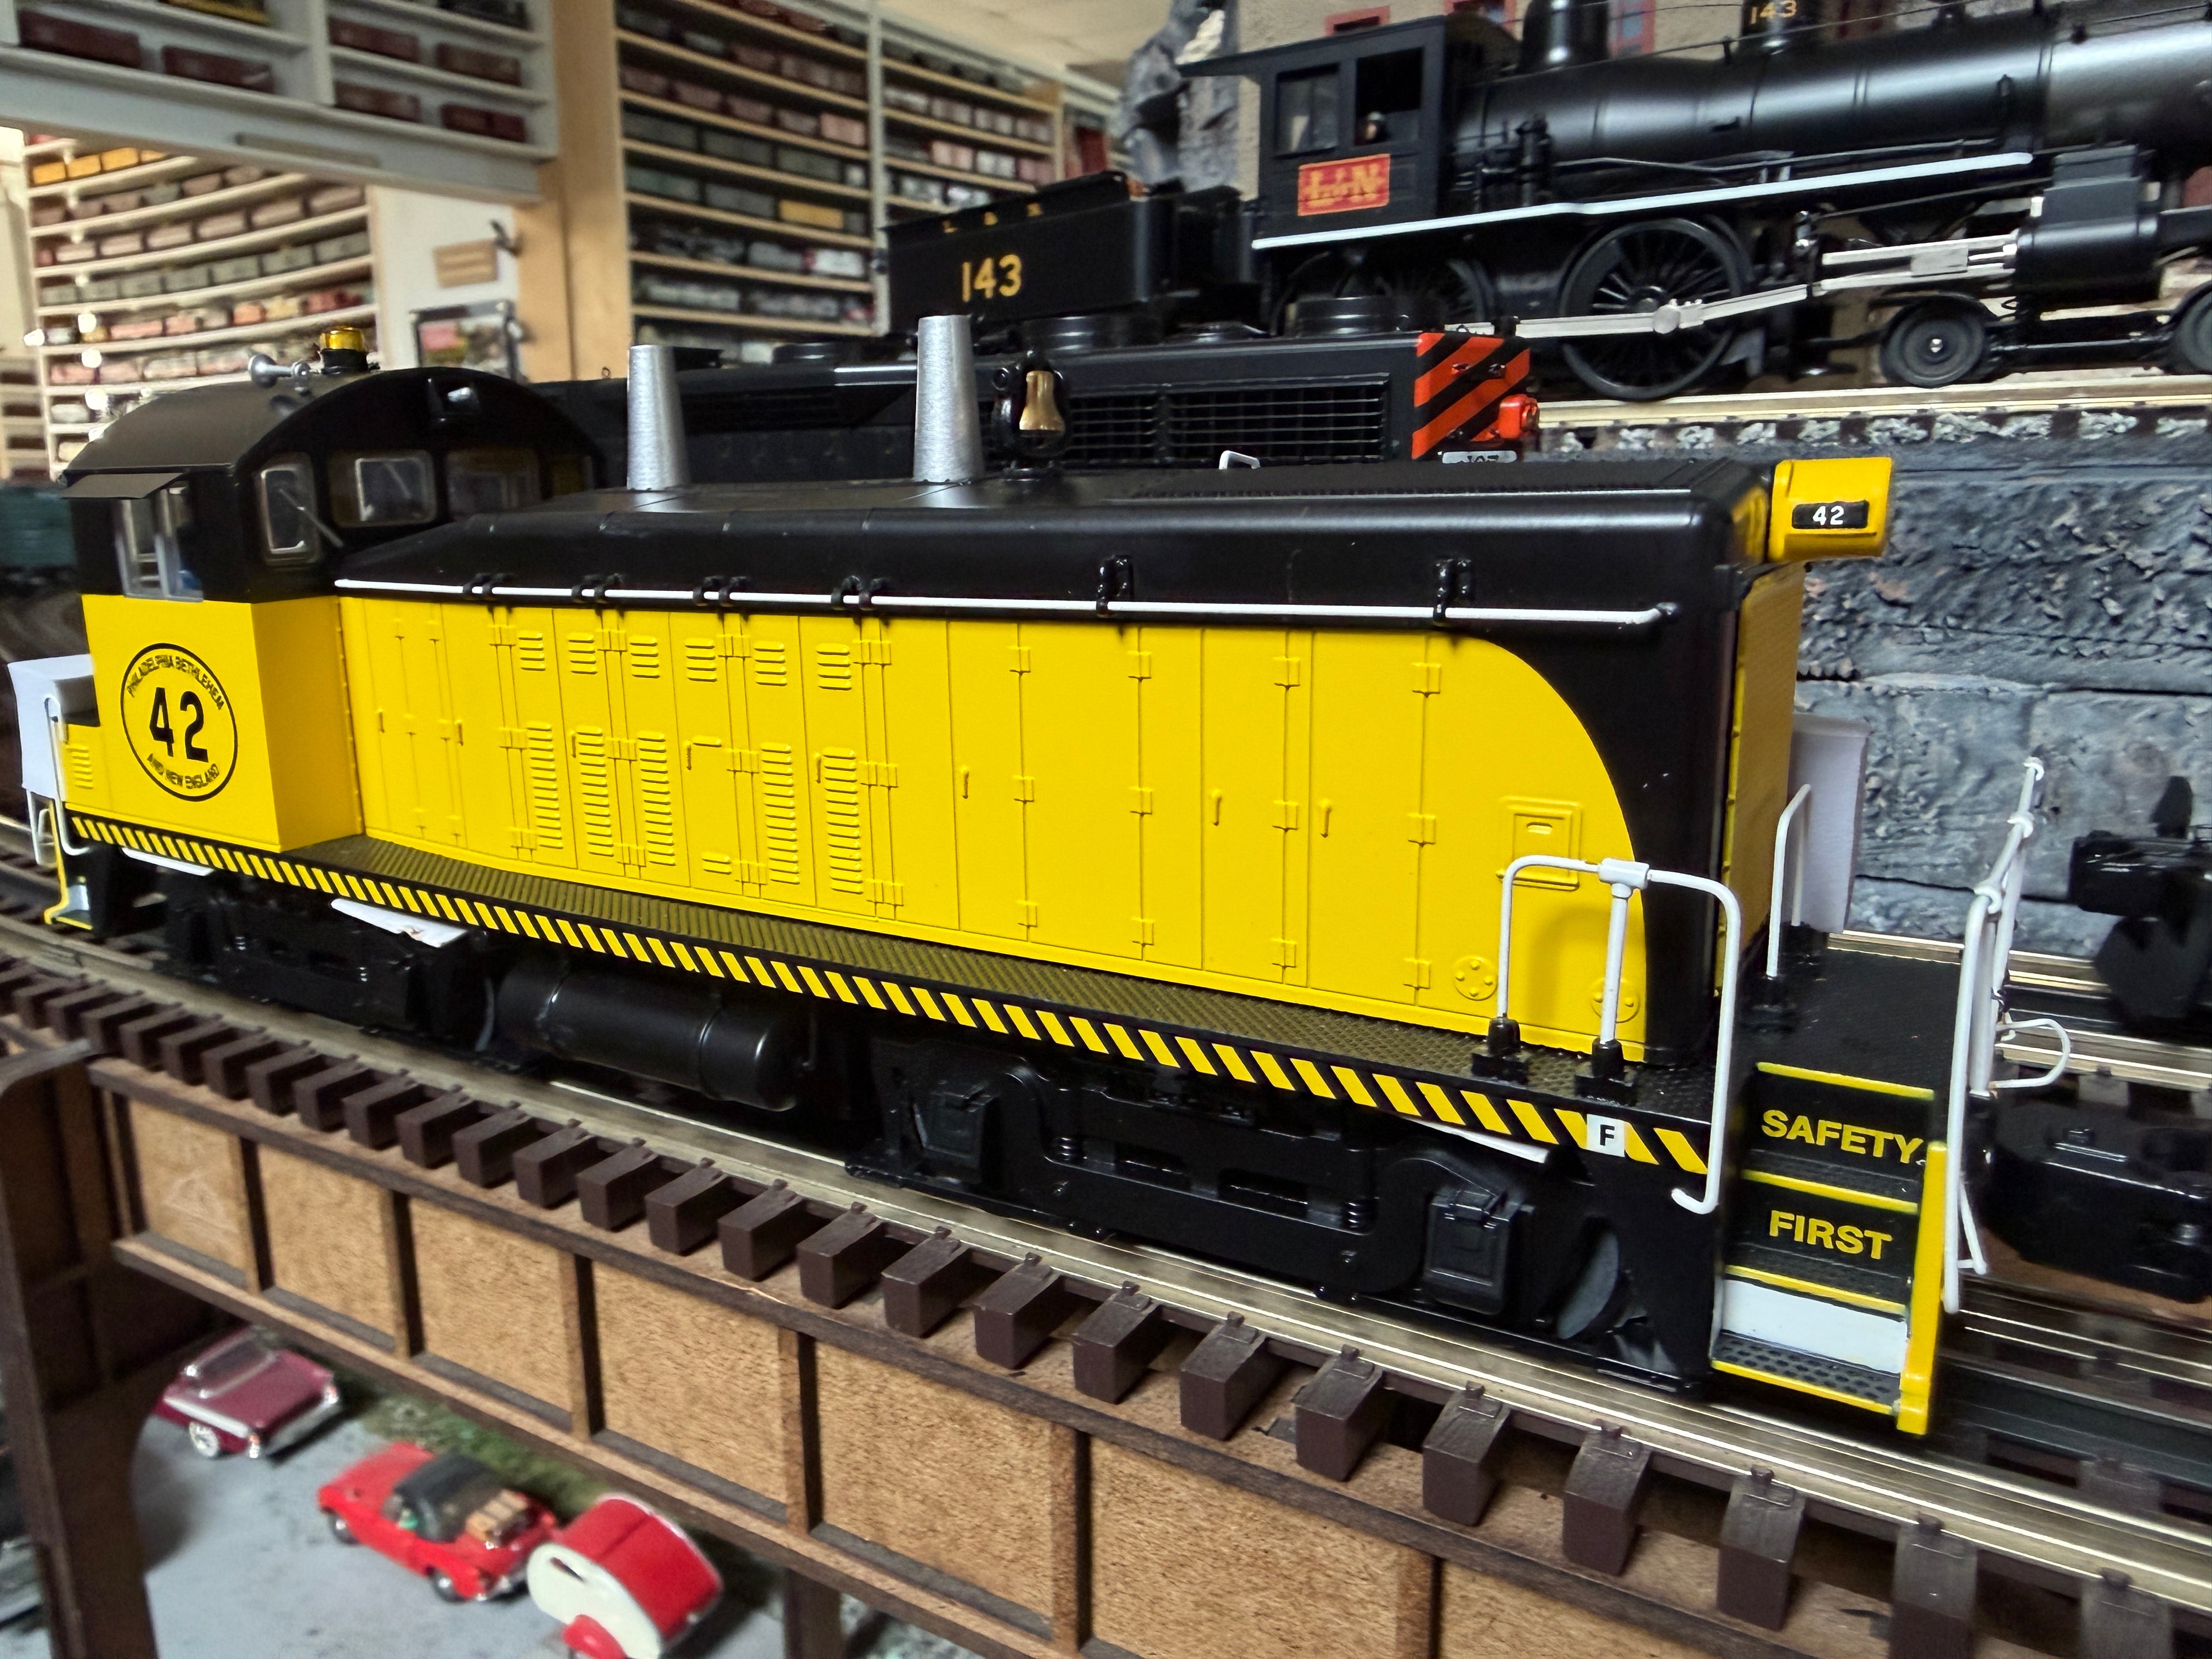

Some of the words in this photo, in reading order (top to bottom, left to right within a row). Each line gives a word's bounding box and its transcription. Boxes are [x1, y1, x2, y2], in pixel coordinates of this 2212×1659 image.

[1751, 0, 1797, 24] 143
[962, 254, 1022, 302] 143
[1812, 505, 1844, 526] 42
[175, 656, 224, 710] BETHLEHEM
[149, 687, 209, 763] 42
[1599, 1124, 1615, 1146] F
[1761, 1109, 1924, 1164] SAFETY
[1769, 1210, 1893, 1260] FIRST
